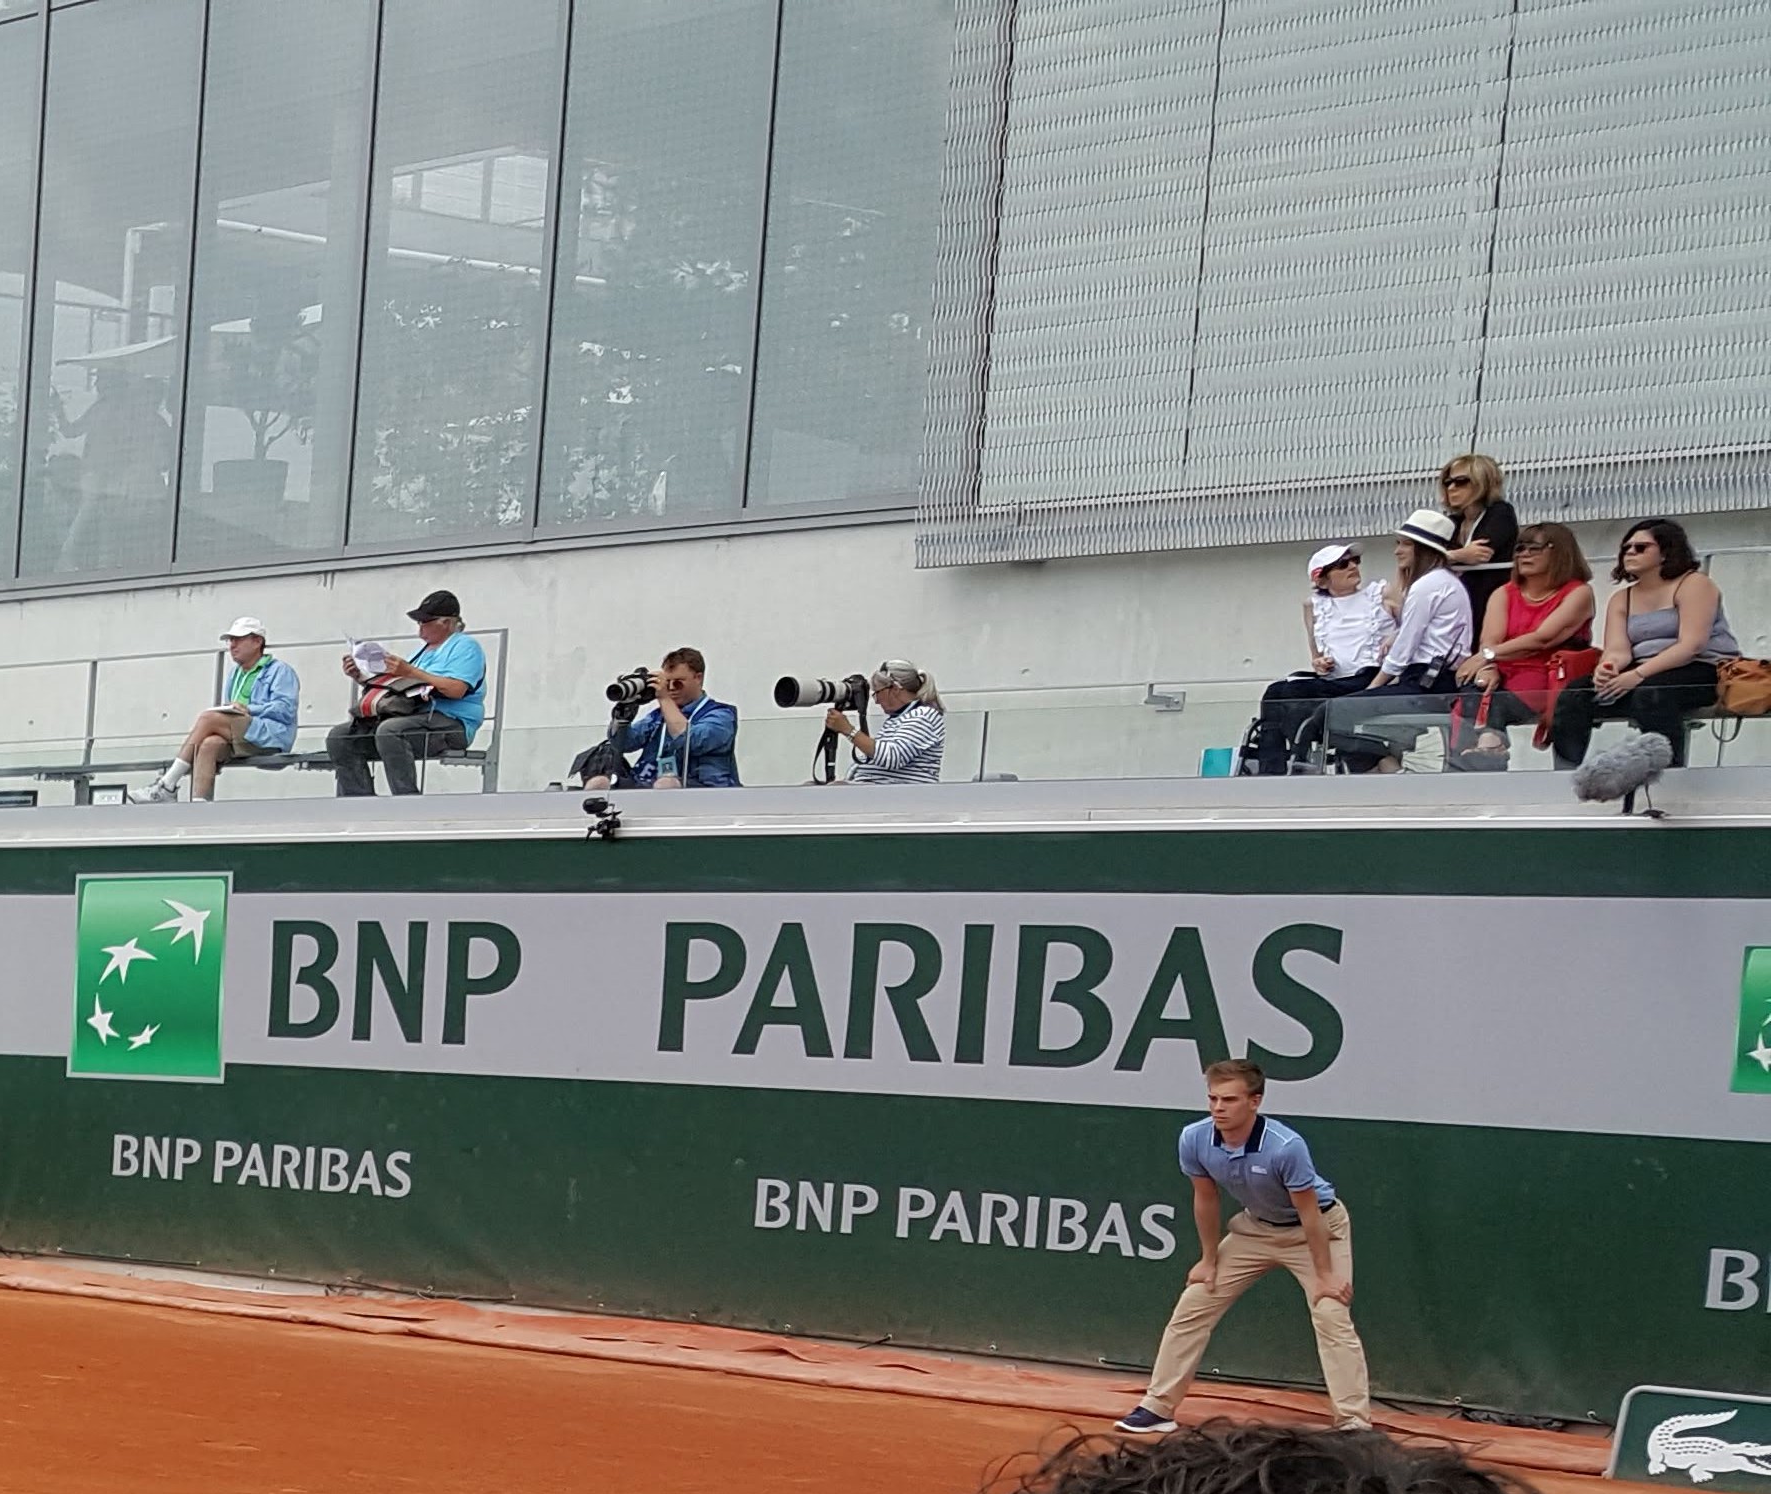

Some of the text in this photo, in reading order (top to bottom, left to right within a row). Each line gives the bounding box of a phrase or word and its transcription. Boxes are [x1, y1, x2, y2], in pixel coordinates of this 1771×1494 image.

[267, 919, 1344, 1081] BNP PARIBAS
[111, 1134, 412, 1198] BNP PARIBAS
[754, 1178, 1176, 1261] BNP PARIBAS
